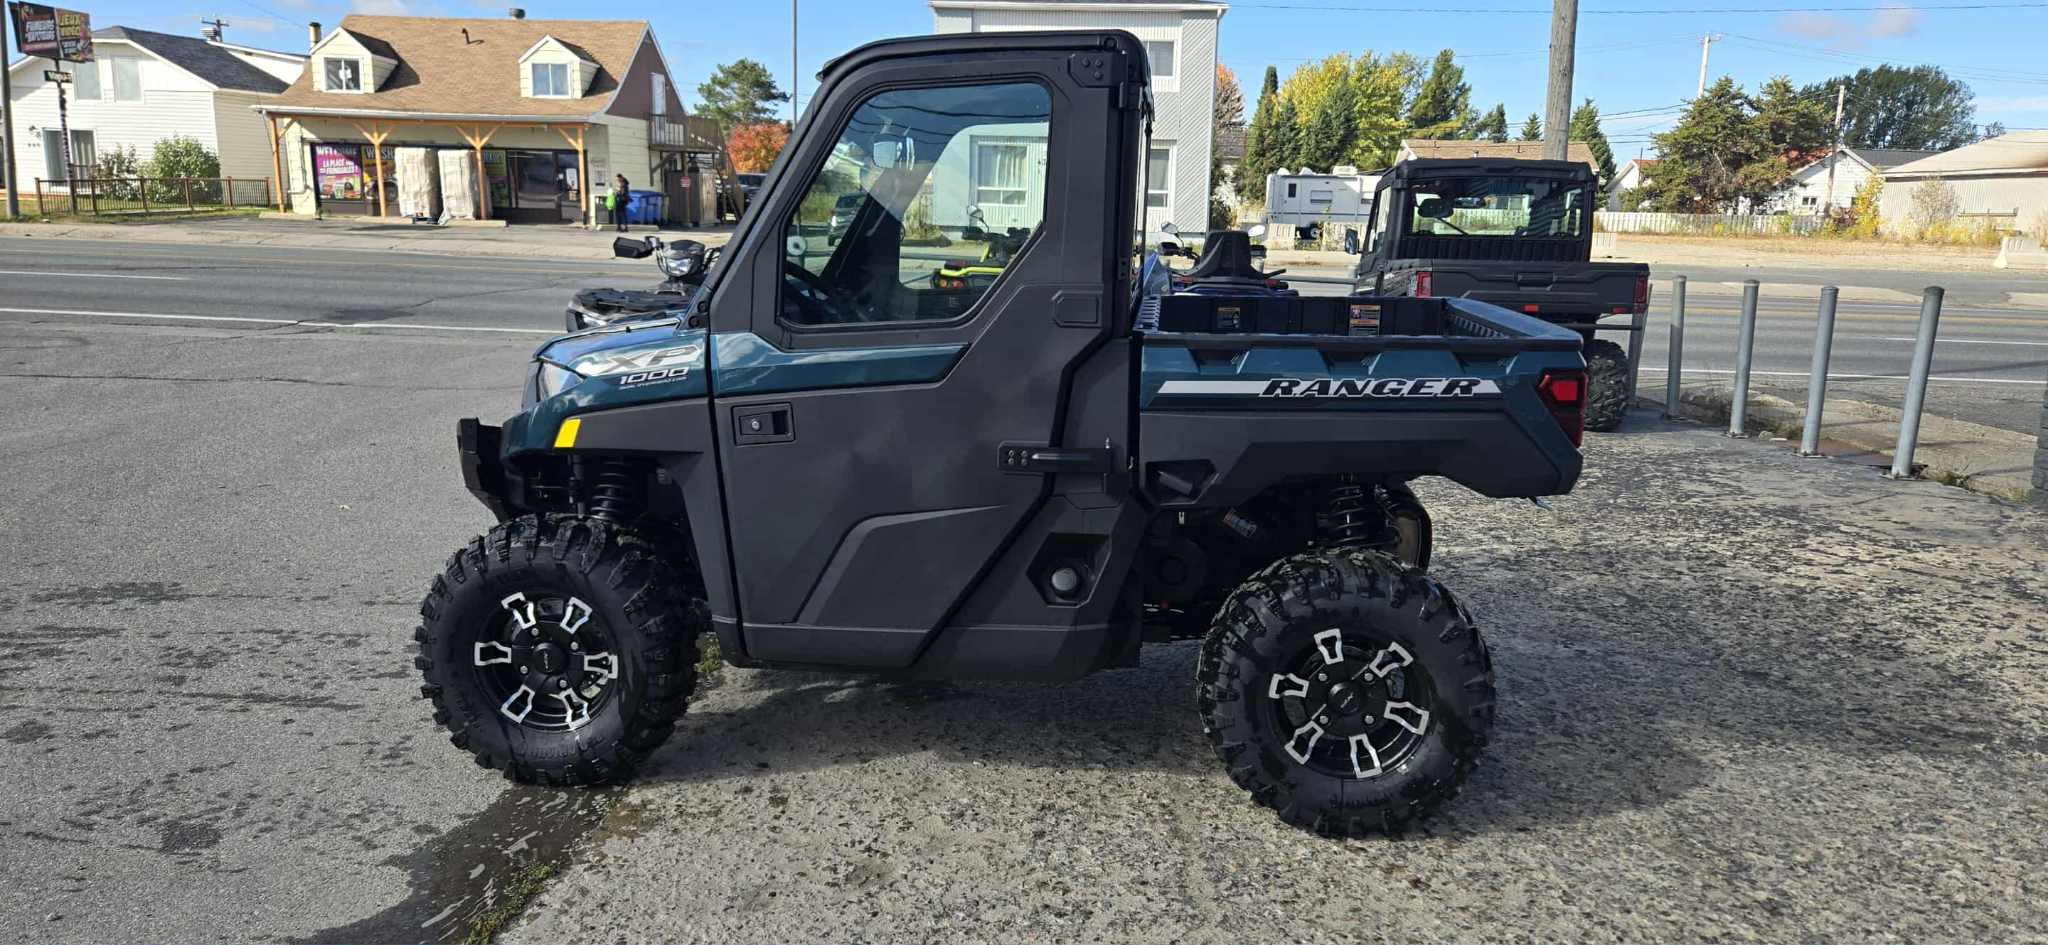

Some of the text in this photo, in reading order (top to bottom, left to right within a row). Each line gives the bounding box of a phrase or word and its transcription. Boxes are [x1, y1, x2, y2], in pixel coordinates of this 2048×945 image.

[602, 345, 700, 372] XP
[620, 367, 689, 385] 1000
[1260, 377, 1482, 398] RANGER
